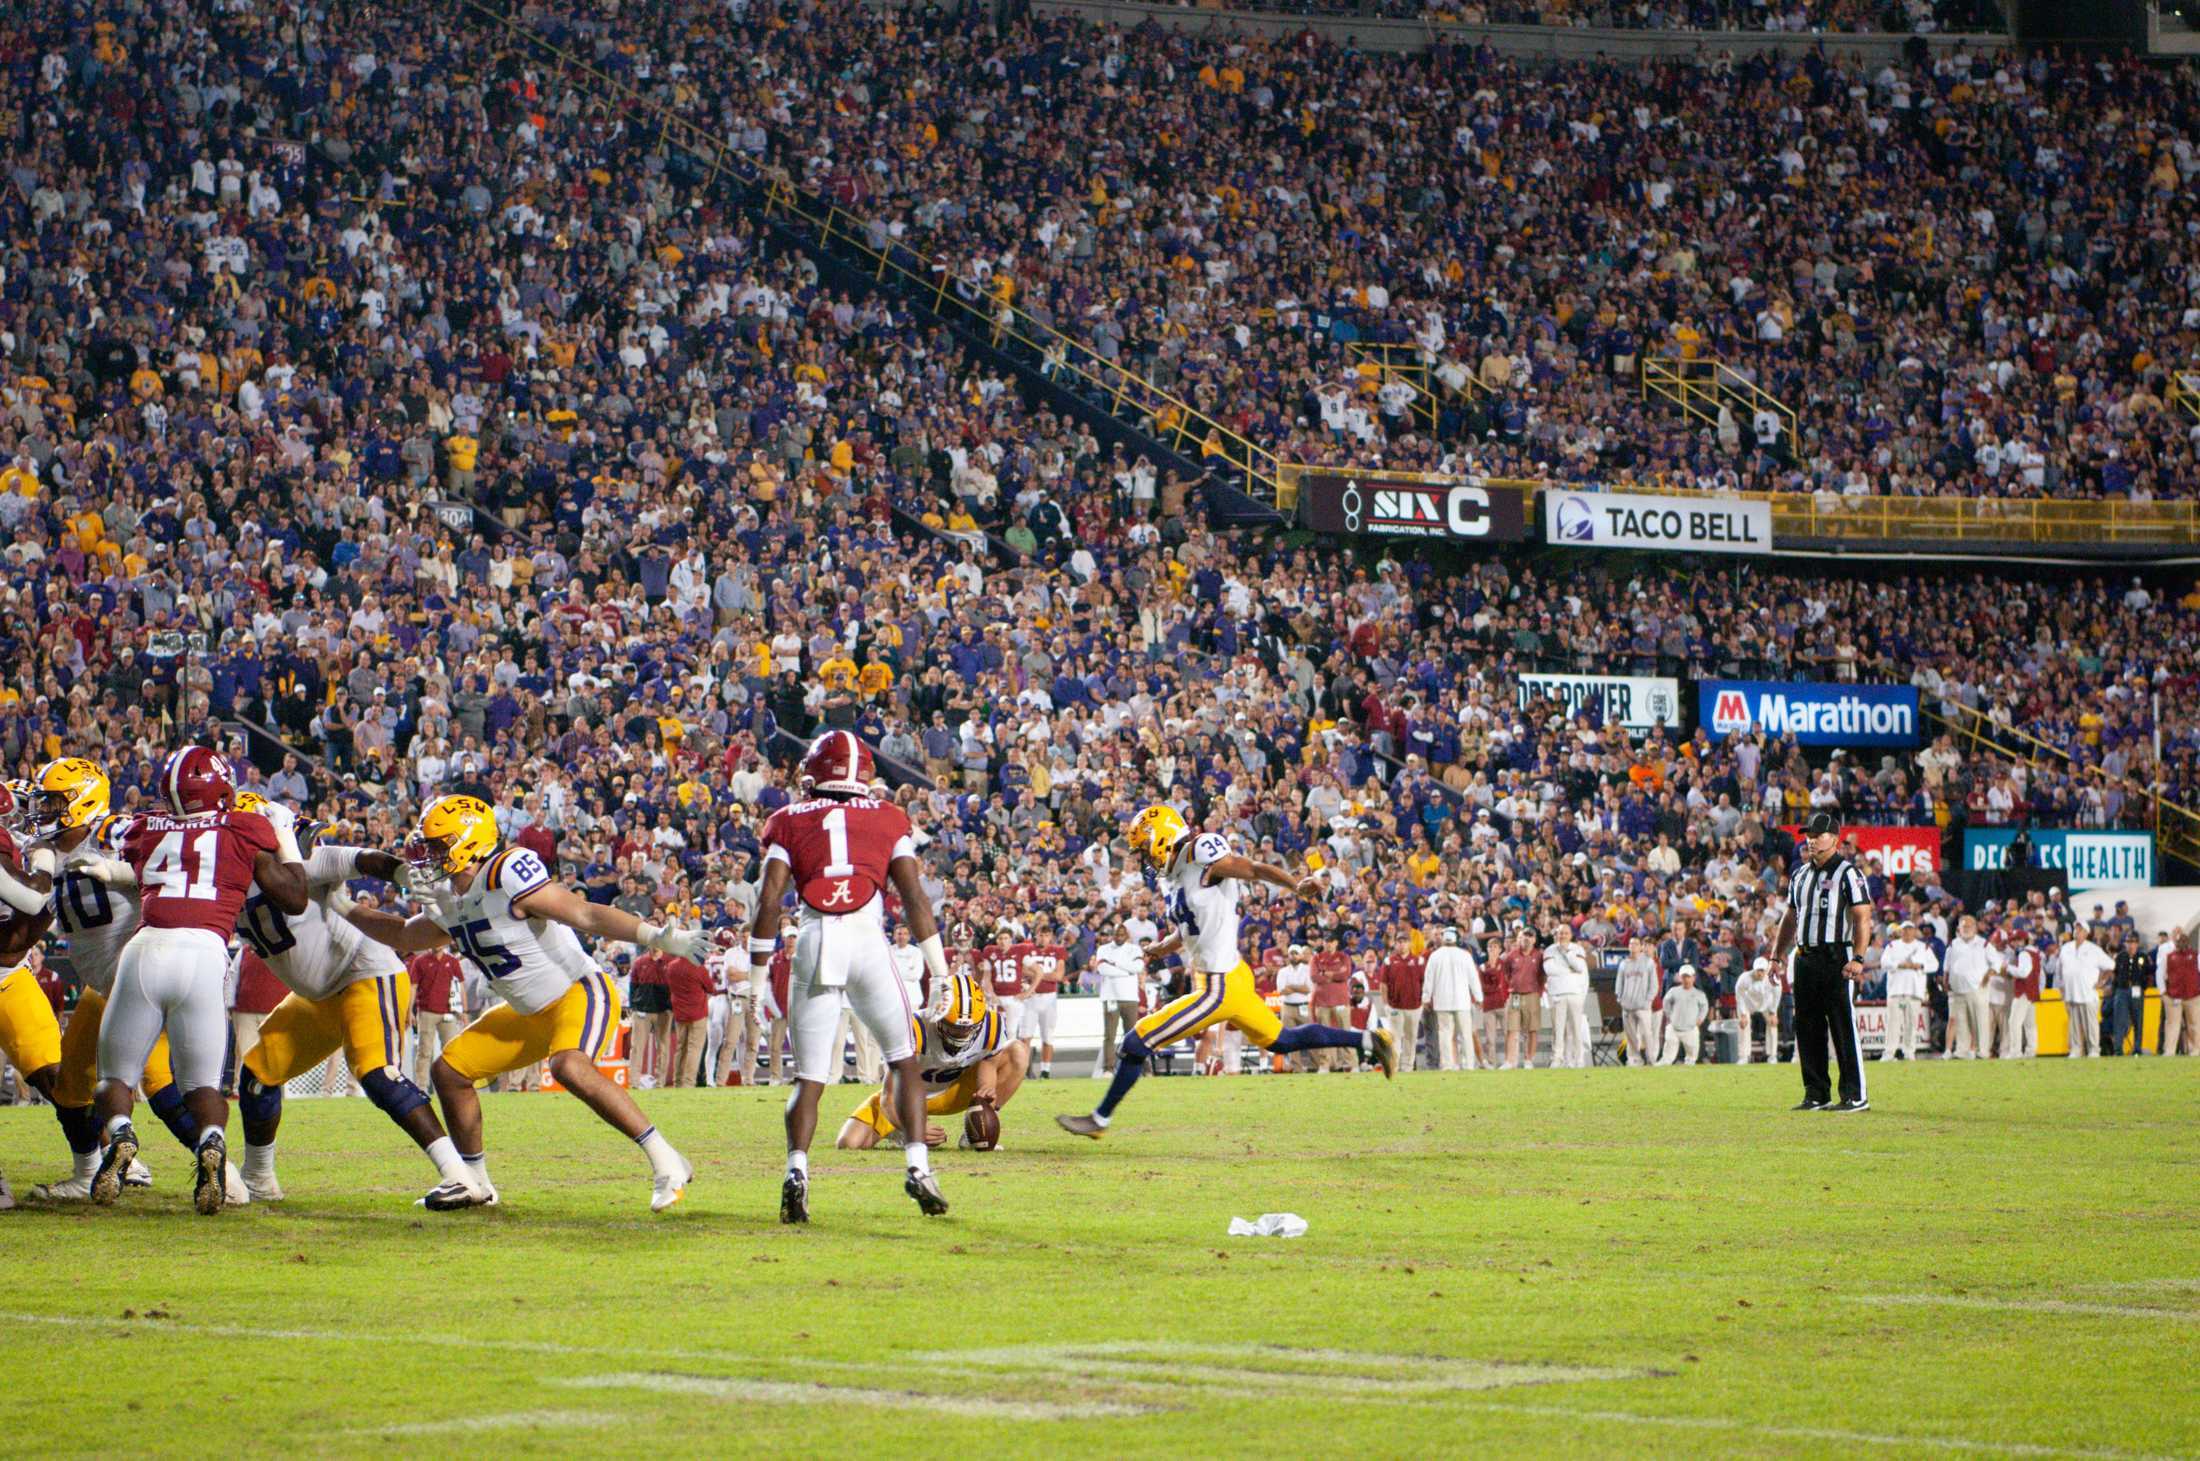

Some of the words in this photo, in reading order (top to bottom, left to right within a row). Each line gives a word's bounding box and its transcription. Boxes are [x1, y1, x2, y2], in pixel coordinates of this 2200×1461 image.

[1374, 490, 1440, 521] SIX
[1448, 486, 1490, 536] C
[1606, 507, 1682, 538] TACO
[1690, 511, 1758, 543] BELL
[1759, 693, 1911, 735] Marathon
[442, 798, 486, 814] LSU
[788, 797, 881, 816] McKINTRY
[822, 808, 854, 878] 1
[1200, 837, 1227, 858] 34
[142, 831, 219, 901] 41
[511, 853, 542, 883] 85
[1865, 844, 1934, 877] ald's
[2072, 845, 2146, 880] HEALTH
[994, 959, 1018, 983] 16
[1858, 1013, 1926, 1033] ALAA
